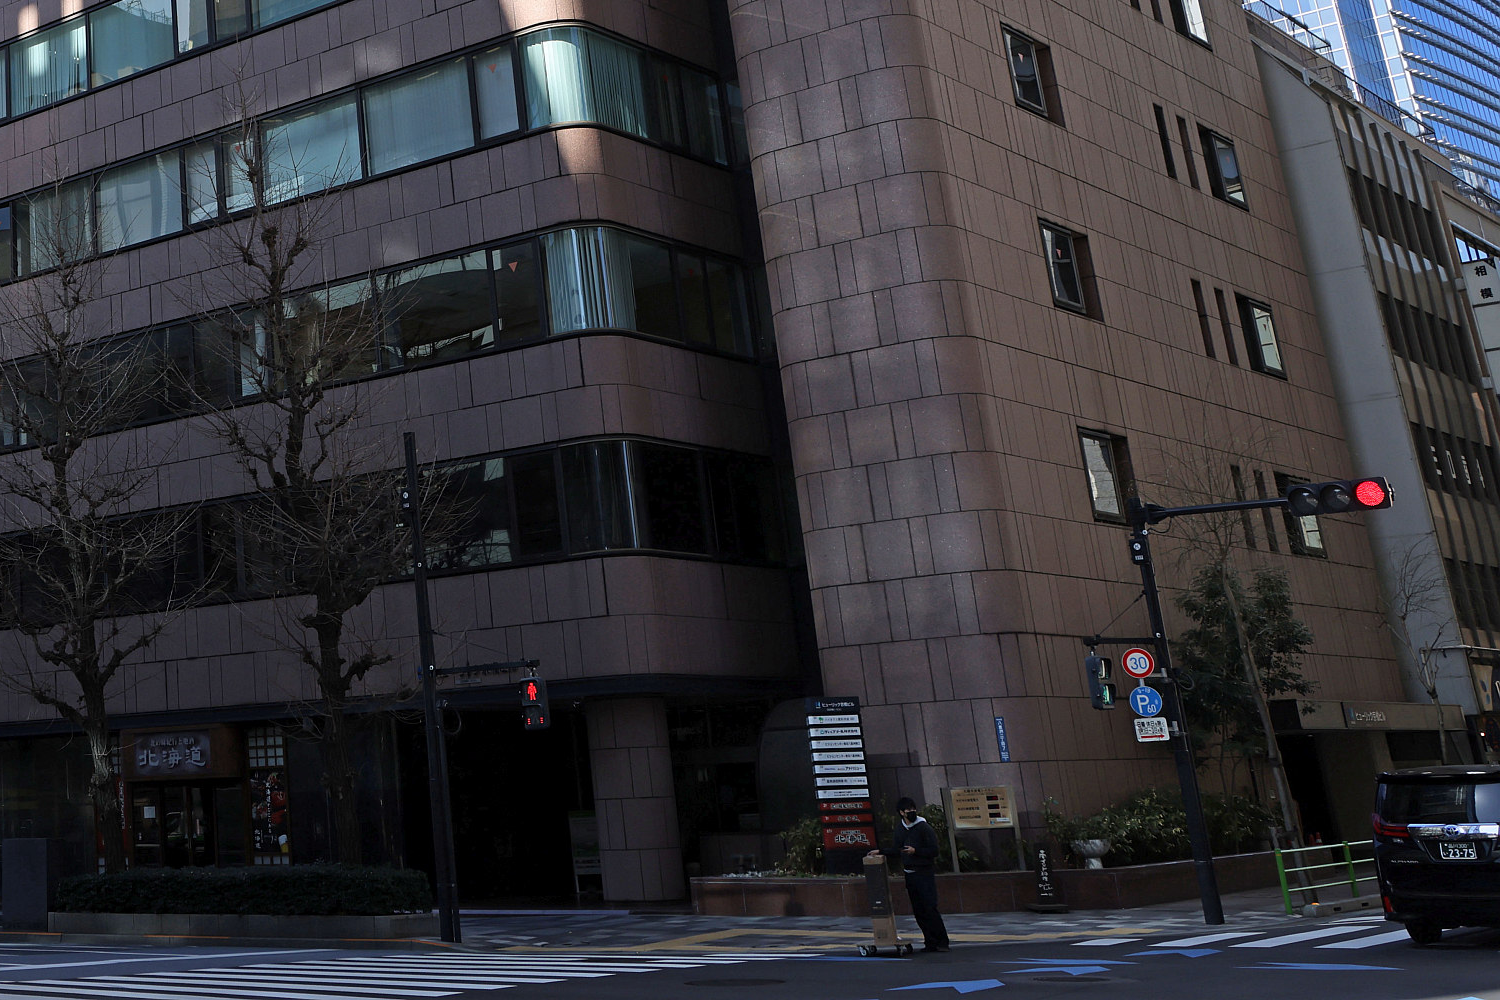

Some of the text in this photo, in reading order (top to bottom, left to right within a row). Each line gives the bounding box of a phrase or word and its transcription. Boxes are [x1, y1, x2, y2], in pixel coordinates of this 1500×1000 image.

[1129, 656, 1148, 670] 30
[1136, 695, 1149, 713] P
[1147, 704, 1157, 713] 60
[139, 746, 206, 769] 北海道
[1448, 849, 1475, 858] 23-75
